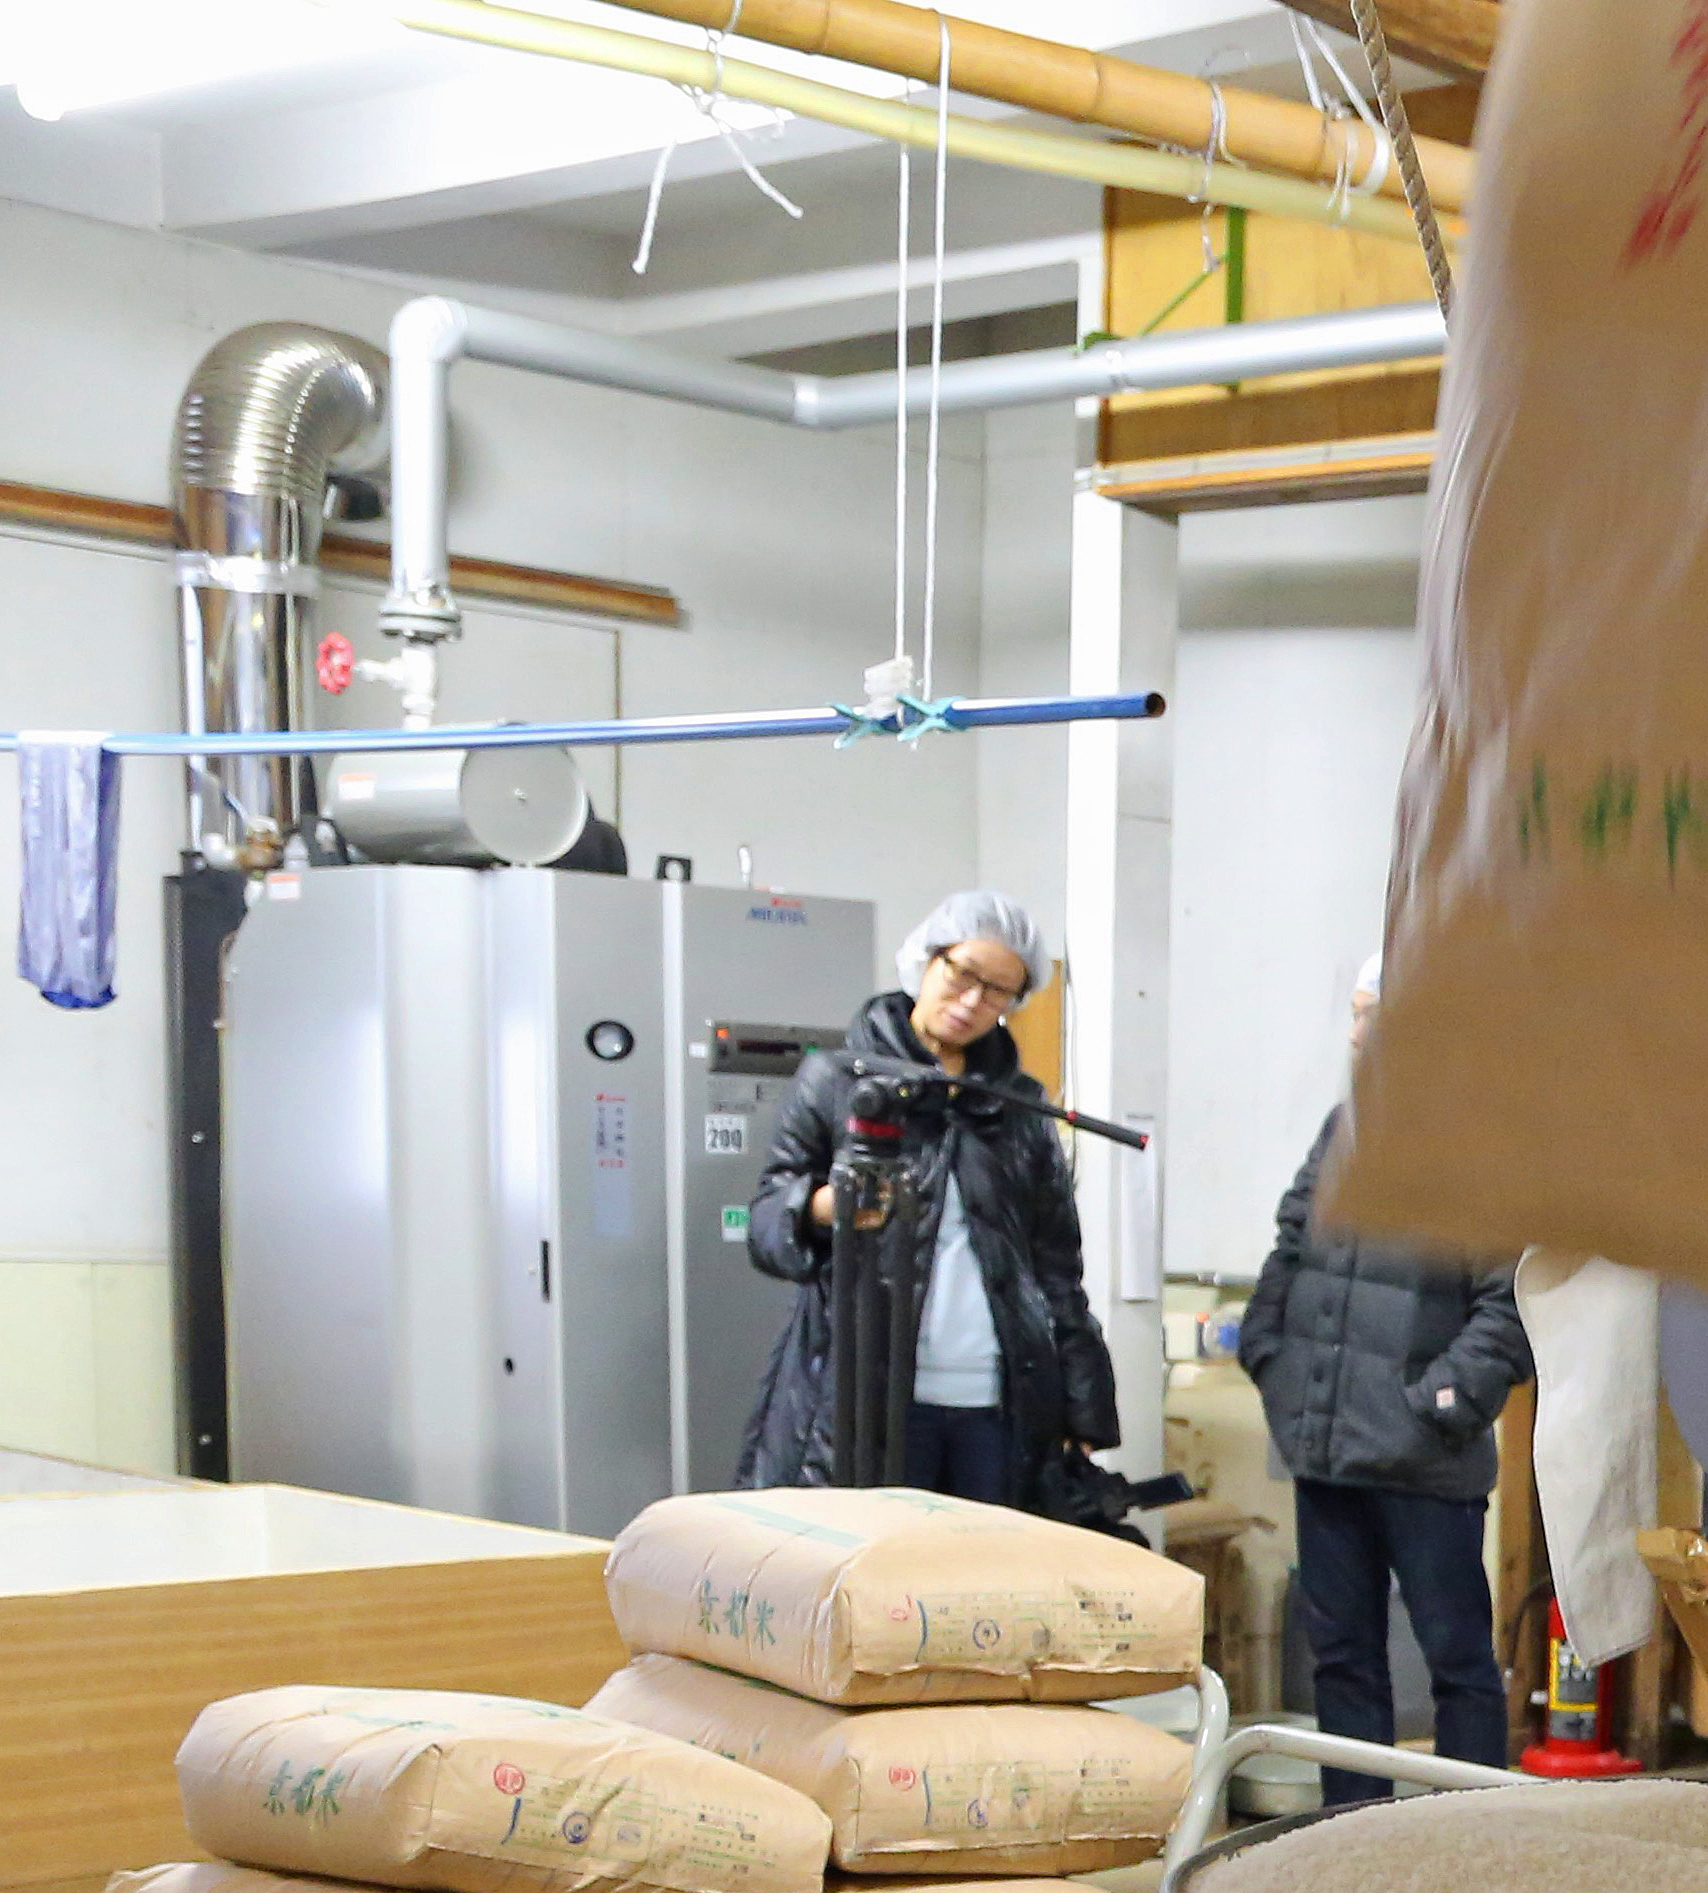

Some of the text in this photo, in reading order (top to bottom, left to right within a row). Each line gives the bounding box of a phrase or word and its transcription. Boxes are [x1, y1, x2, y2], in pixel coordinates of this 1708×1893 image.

[699, 1579, 776, 1650] 京都米
[263, 1760, 342, 1829] 京都米
